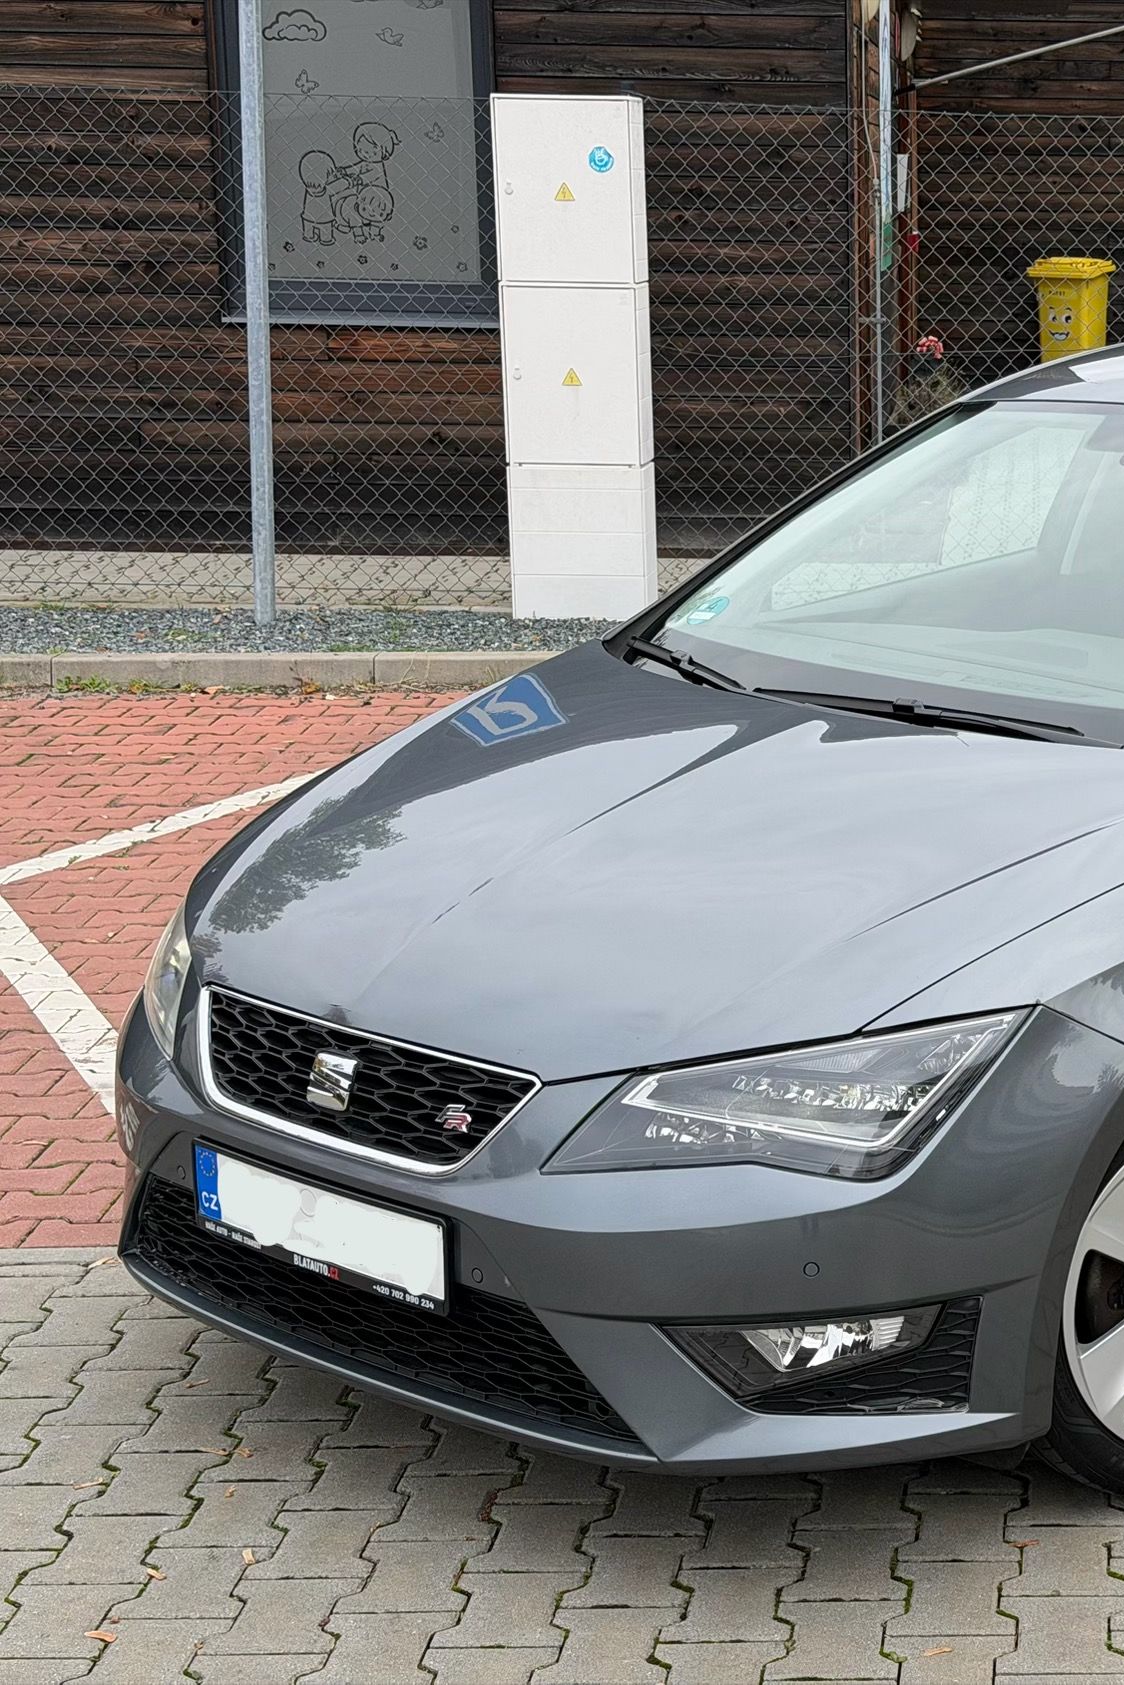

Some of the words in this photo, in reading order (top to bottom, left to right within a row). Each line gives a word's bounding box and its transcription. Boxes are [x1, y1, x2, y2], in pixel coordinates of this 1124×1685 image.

[201, 1191, 219, 1211] CZ
[293, 1253, 340, 1281] BLATAUTO.CZ
[372, 1284, 390, 1296] +420
[390, 1289, 404, 1300] 702
[420, 1298, 435, 1310] 234
